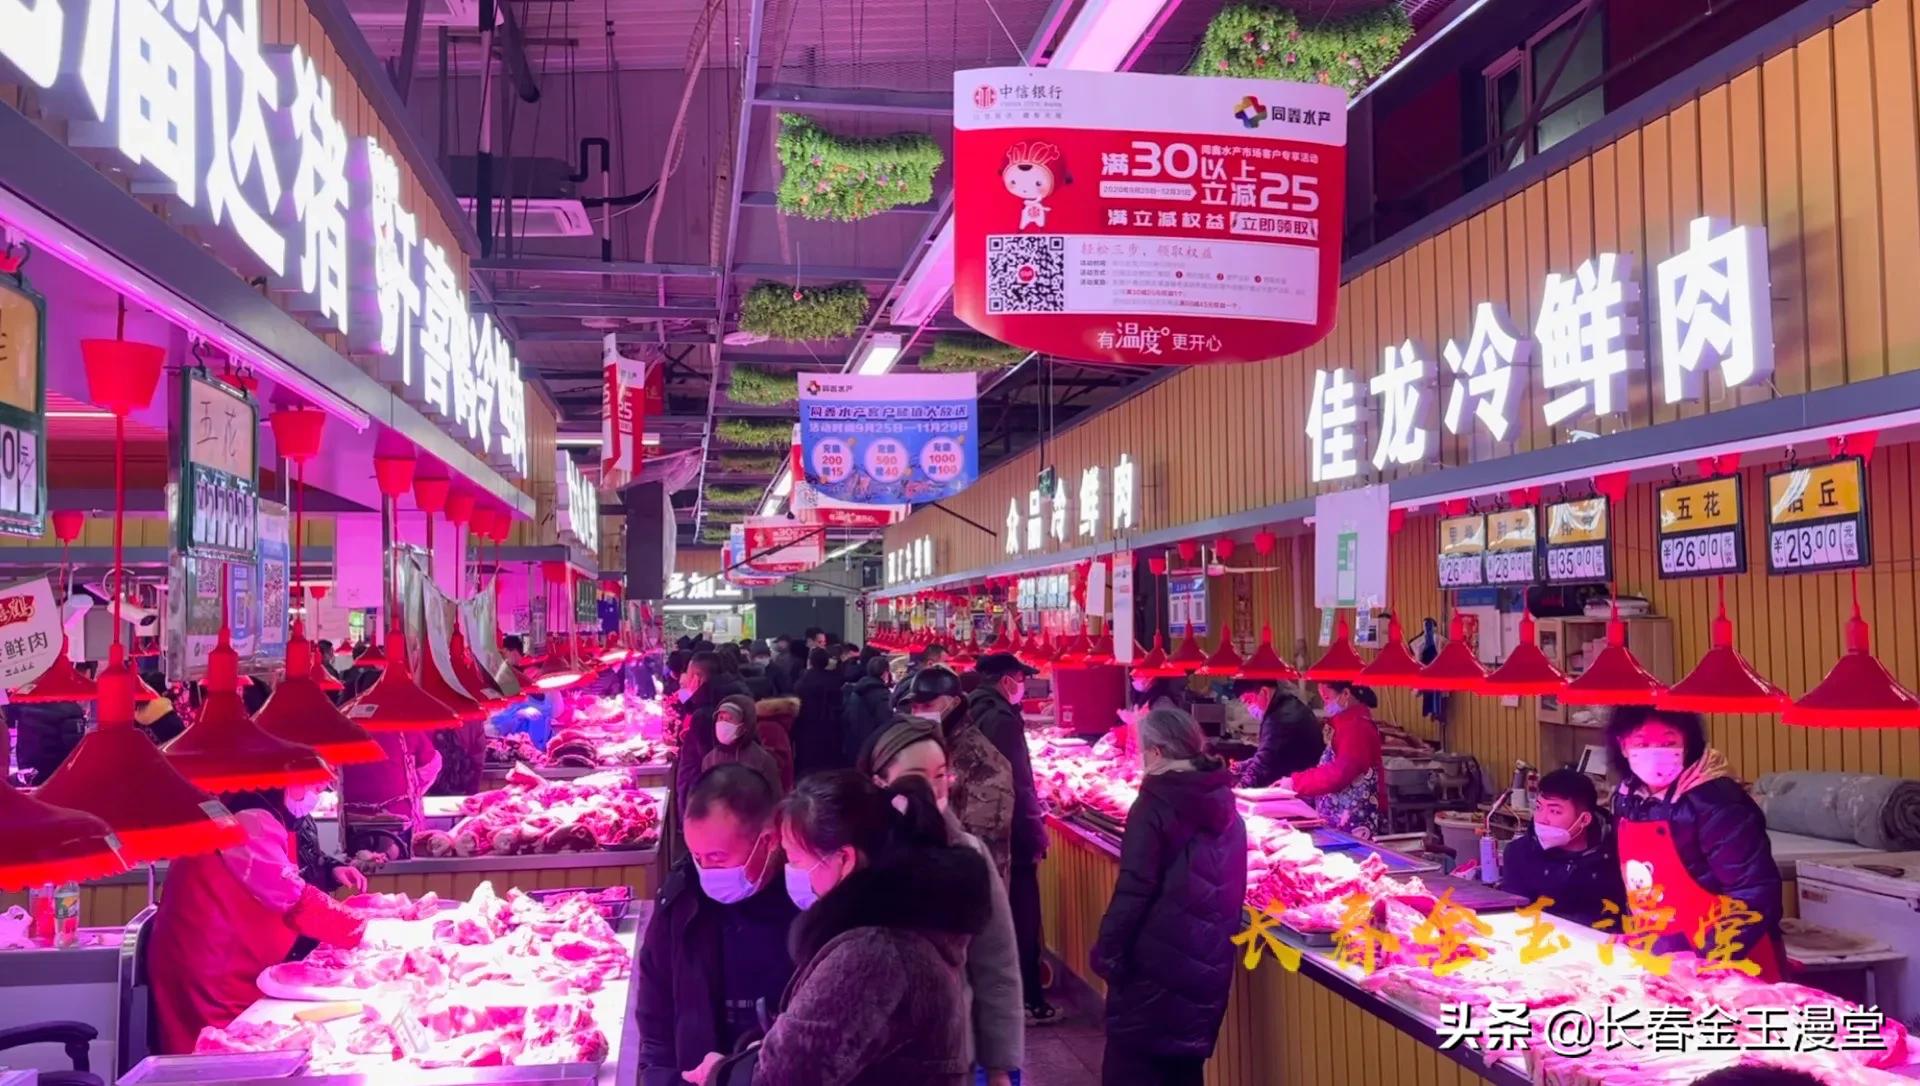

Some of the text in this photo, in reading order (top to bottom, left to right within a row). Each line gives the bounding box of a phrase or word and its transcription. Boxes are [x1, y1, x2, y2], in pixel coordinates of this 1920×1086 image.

[1000, 84, 1063, 99] 中信银行
[1271, 106, 1331, 126] 同鑫水产
[1101, 141, 1257, 182] 满30以上
[1201, 171, 1320, 212] 立减25
[1107, 209, 1225, 230] 满立减权益
[1241, 217, 1309, 236] 立即领取
[1305, 215, 1756, 482] 佳龙冷鲜肉
[822, 455, 843, 465] 200
[876, 455, 897, 465] 500
[929, 454, 956, 464] 1000
[1677, 491, 1721, 520] 五花
[0, 631, 48, 660] 鲜肉
